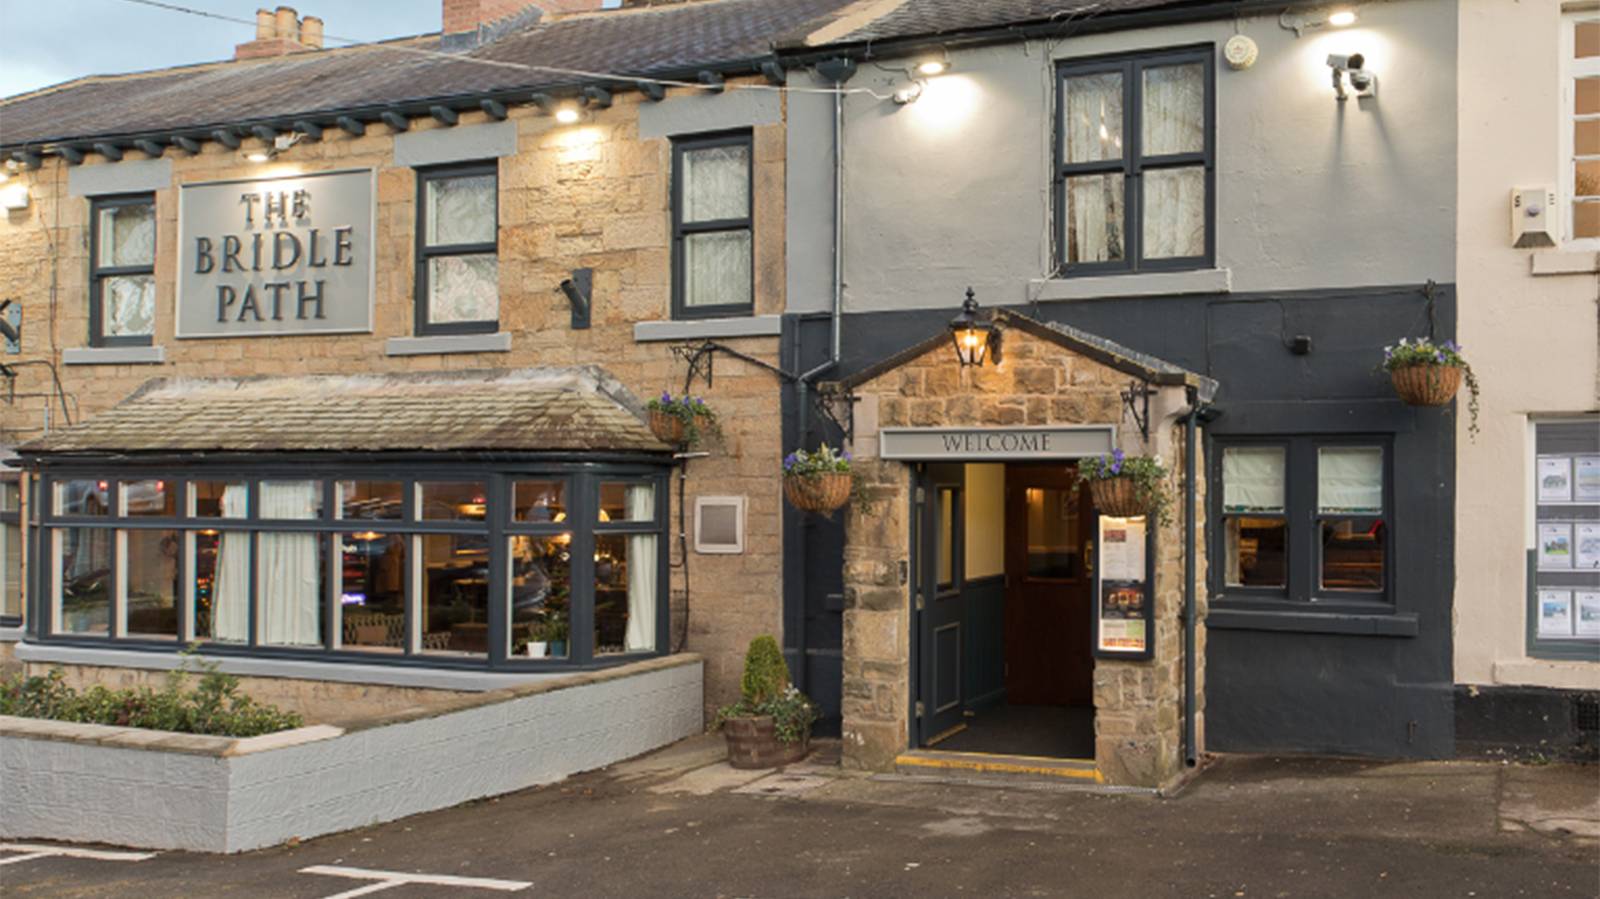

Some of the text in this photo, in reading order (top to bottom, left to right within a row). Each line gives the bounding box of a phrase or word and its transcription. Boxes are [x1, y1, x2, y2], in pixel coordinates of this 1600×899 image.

[240, 189, 311, 224] THE
[194, 227, 353, 274] BRIDLE
[216, 279, 326, 323] PATH
[942, 433, 1051, 452] WELCOME
